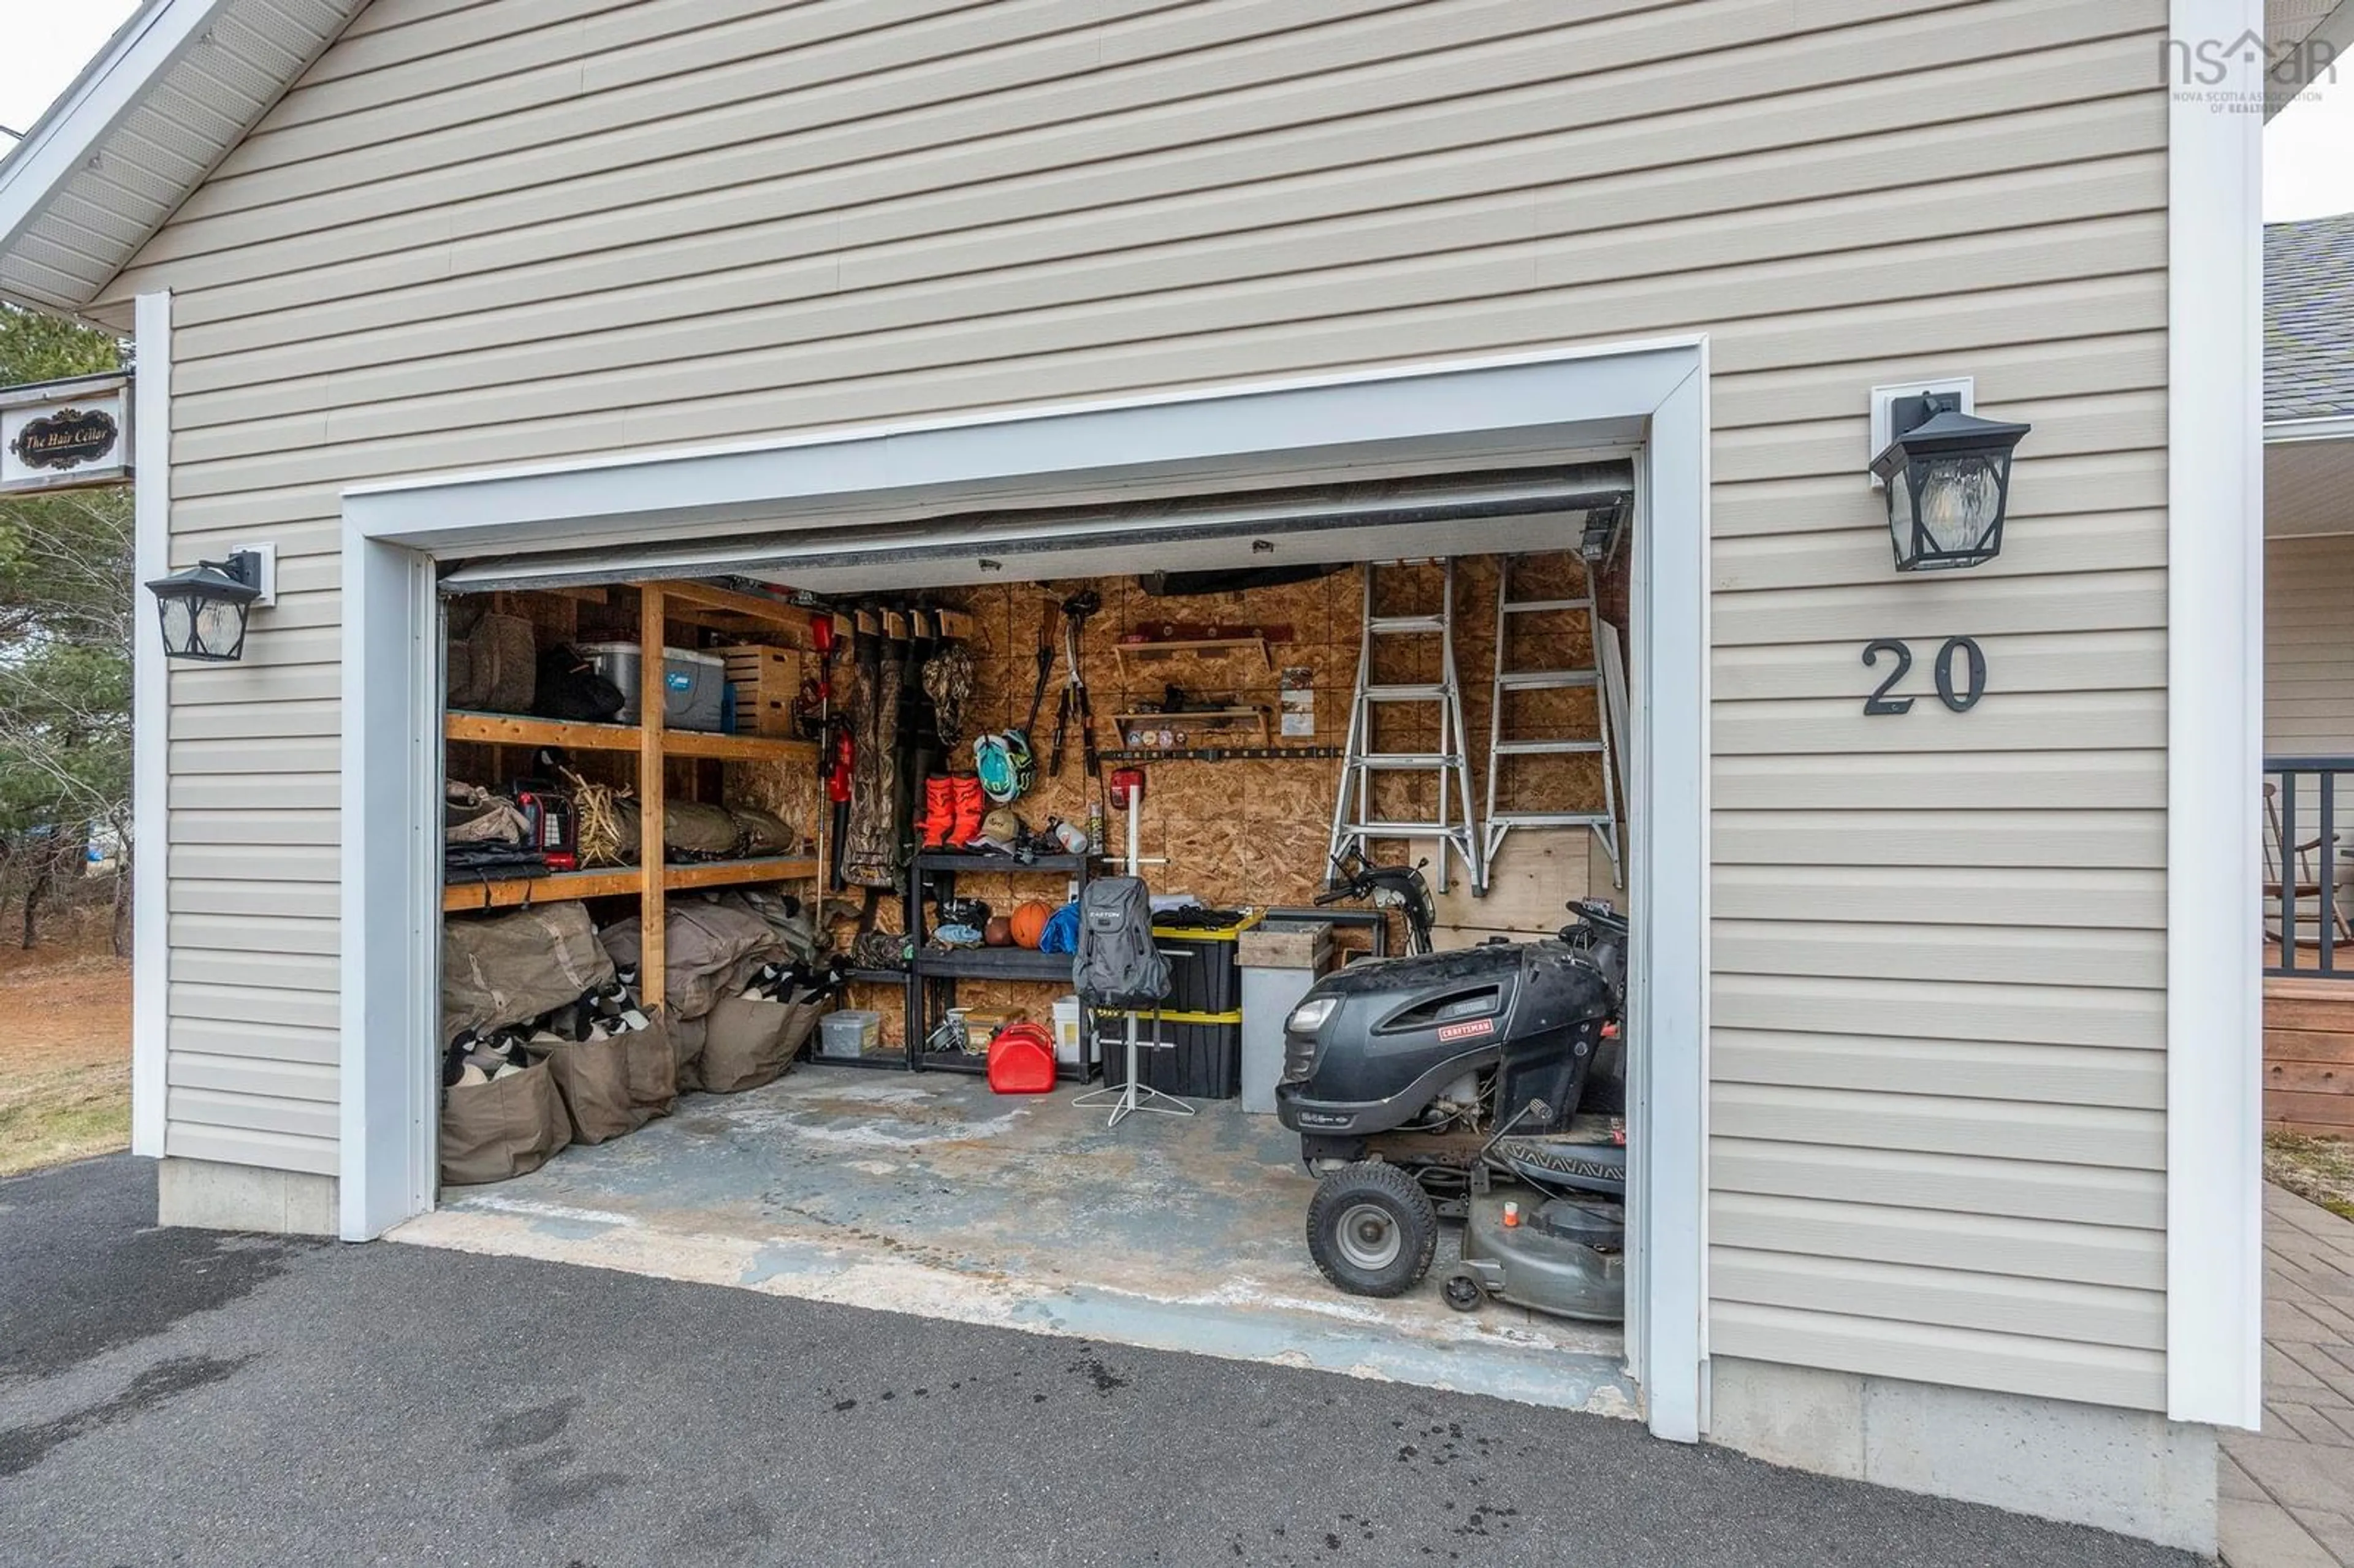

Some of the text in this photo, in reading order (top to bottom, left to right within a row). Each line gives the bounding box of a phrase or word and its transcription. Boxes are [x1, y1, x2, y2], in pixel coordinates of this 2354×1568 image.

[27, 427, 108, 448] The Hair Cellar
[1862, 635, 1987, 716] 20
[1442, 1021, 1491, 1037] CRAFTSMAN
